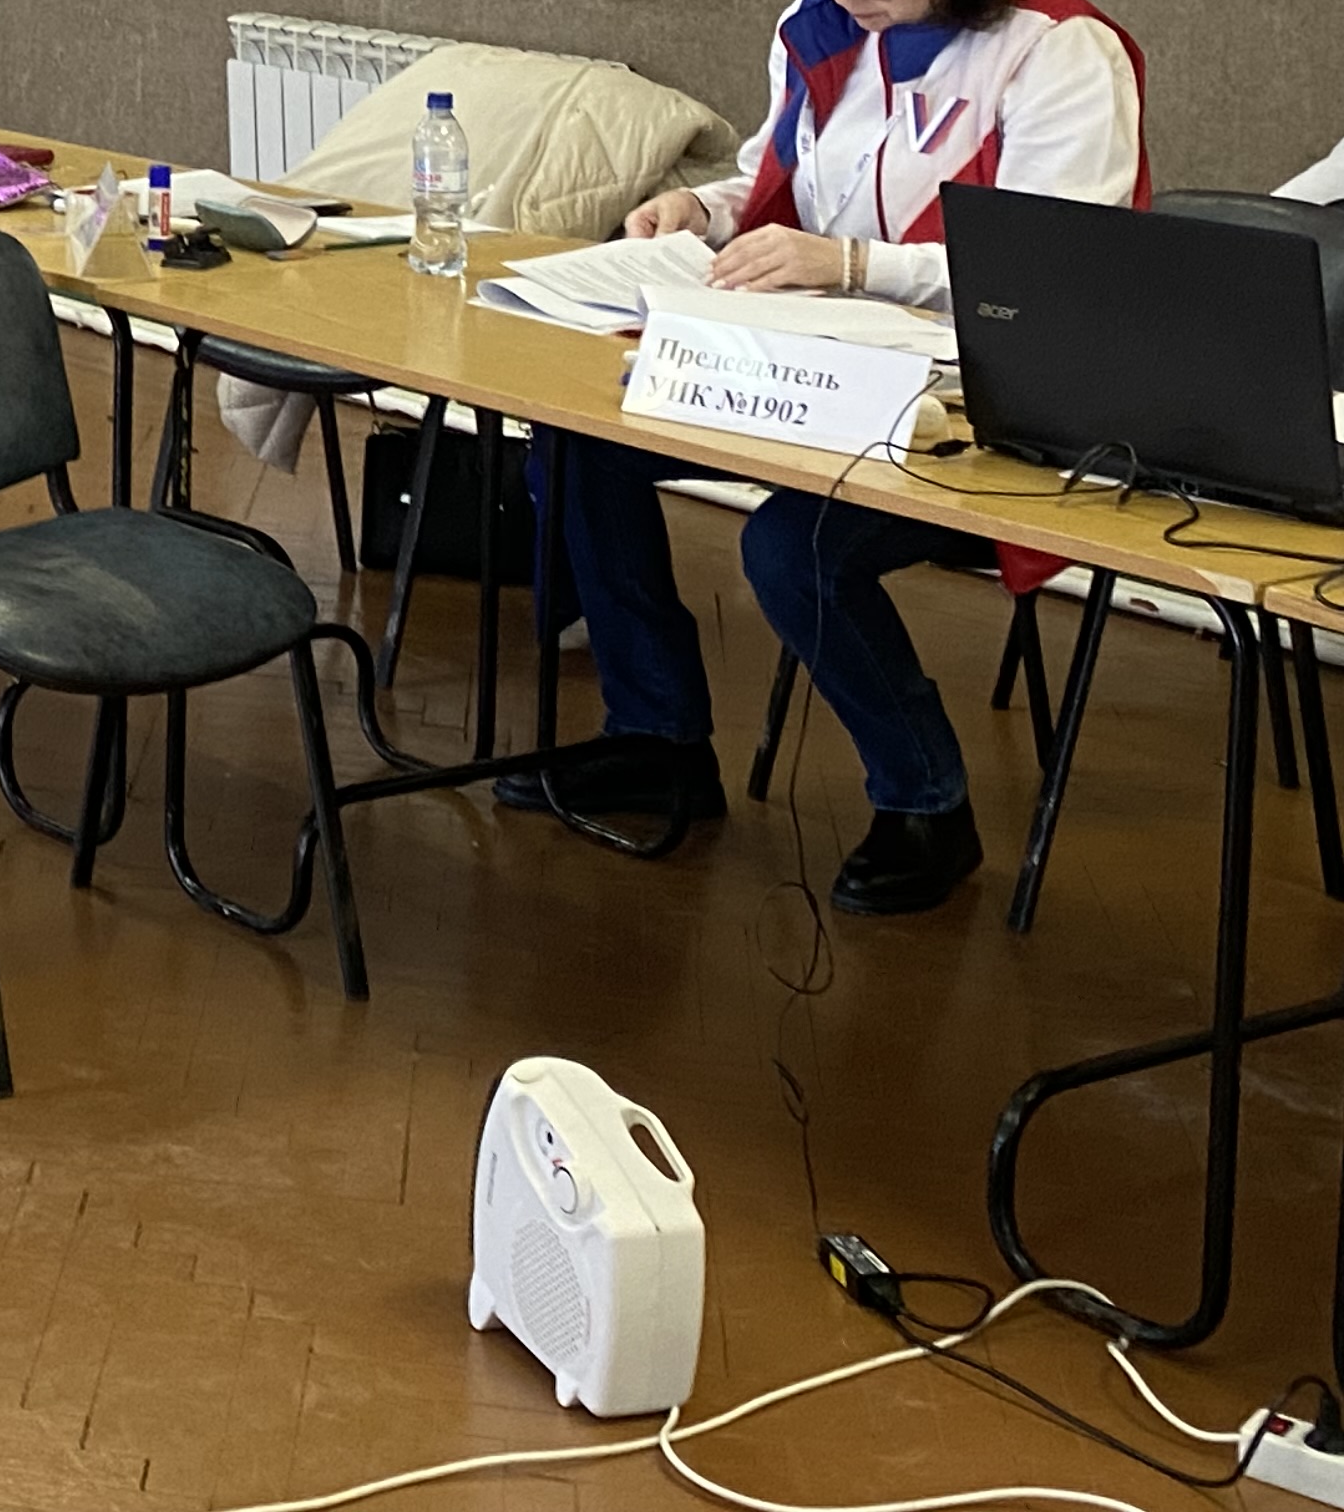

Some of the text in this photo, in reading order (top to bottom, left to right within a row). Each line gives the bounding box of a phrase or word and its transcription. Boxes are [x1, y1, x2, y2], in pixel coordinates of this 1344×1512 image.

[977, 302, 1019, 320] acer
[656, 337, 841, 392] Председатель
[646, 374, 810, 427] УИК №1902
